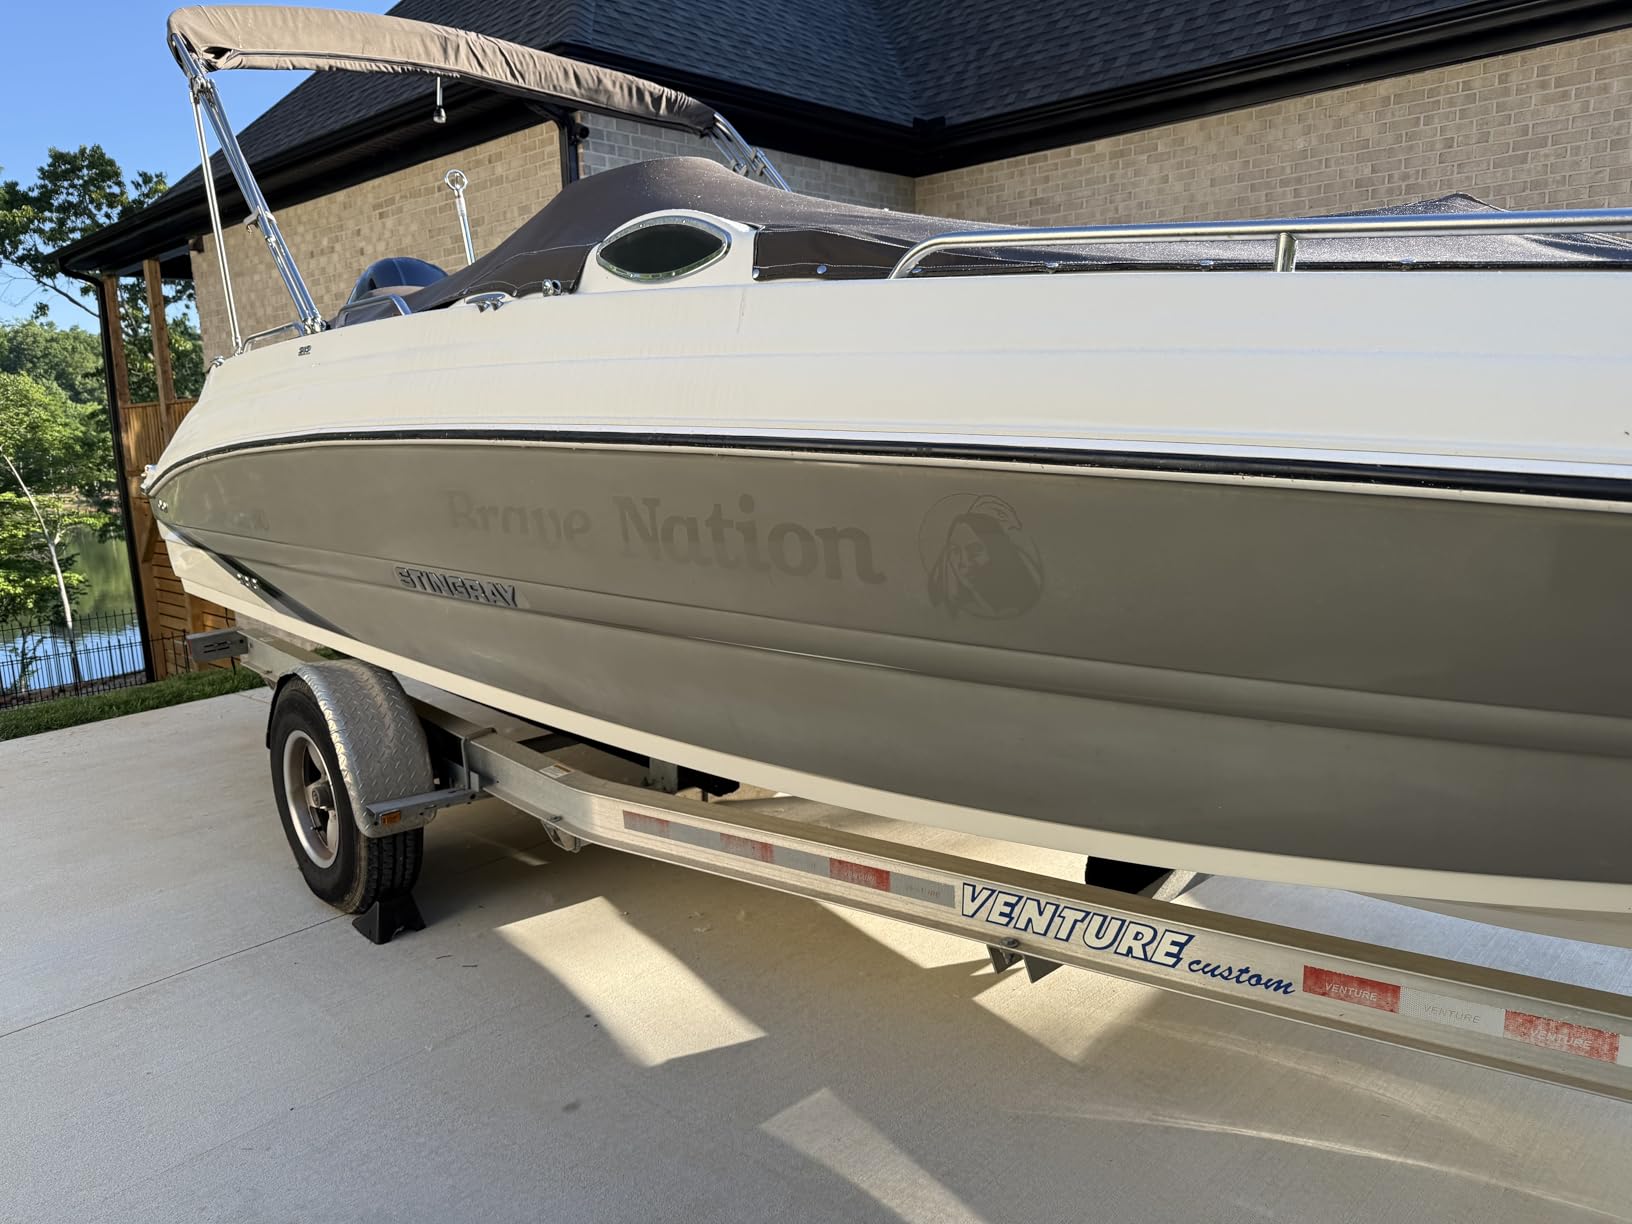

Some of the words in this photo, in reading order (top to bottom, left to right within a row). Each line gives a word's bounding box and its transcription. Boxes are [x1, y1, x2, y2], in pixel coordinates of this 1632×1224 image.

[613, 493, 887, 585] Nation
[395, 566, 518, 608] STINGRAY
[961, 882, 1195, 969] VENTURE
[1187, 958, 1296, 995] custom
[1325, 981, 1378, 1002] VENTURE
[1424, 1004, 1481, 1024] VENTURE
[1530, 1029, 1593, 1050] VENTURE
